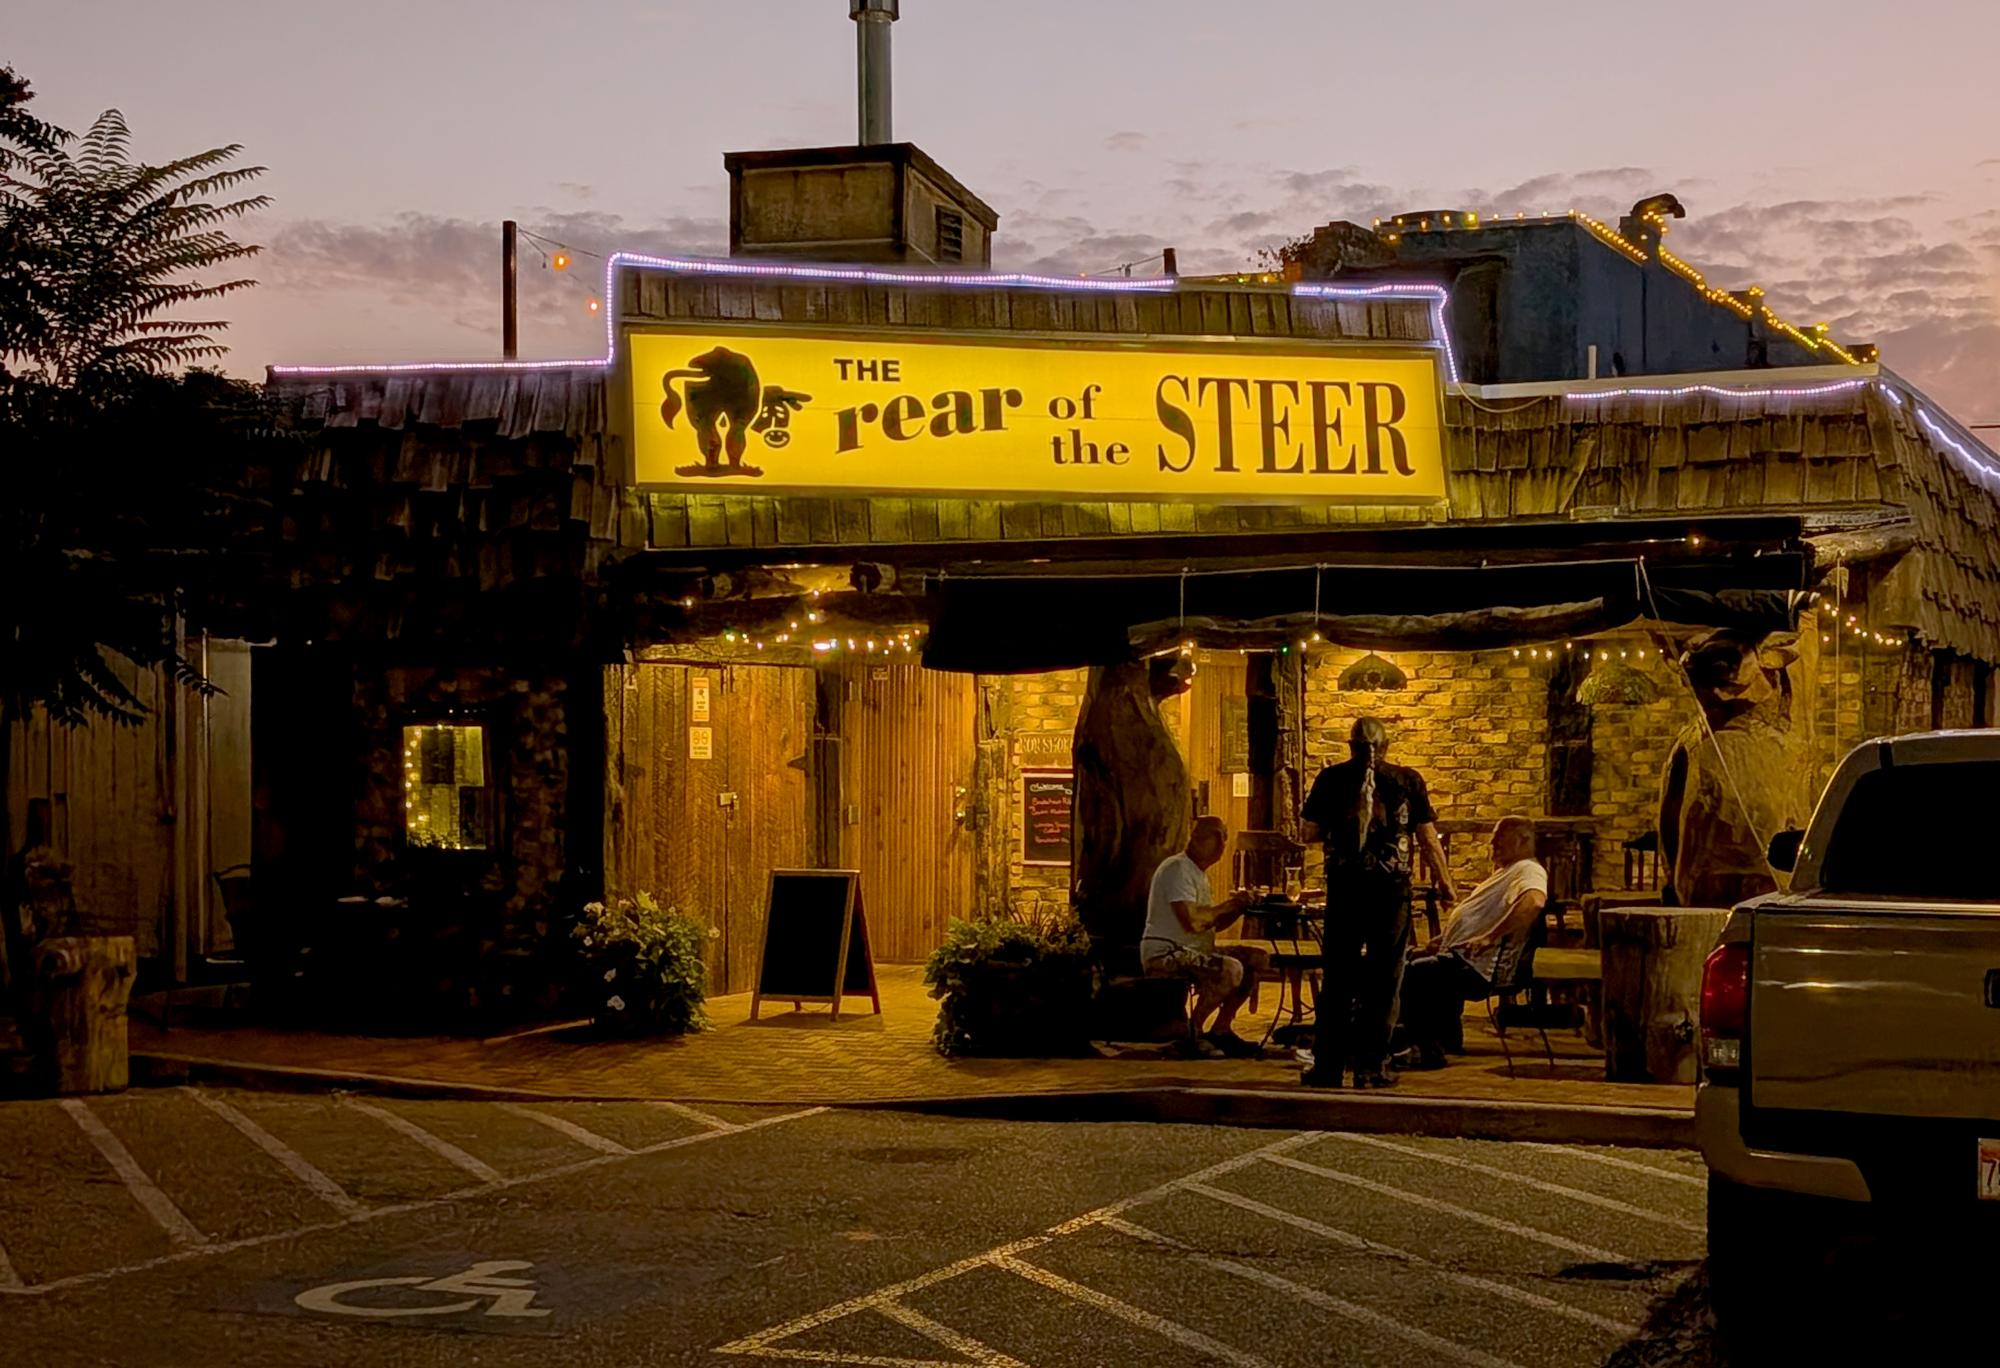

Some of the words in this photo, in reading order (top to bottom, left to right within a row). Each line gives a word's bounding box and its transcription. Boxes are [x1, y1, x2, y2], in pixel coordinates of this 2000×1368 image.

[833, 358, 901, 382] THE
[833, 387, 1023, 454] rear
[1048, 384, 1102, 420] of
[1155, 374, 1416, 477] STEER
[1050, 428, 1130, 465] the
